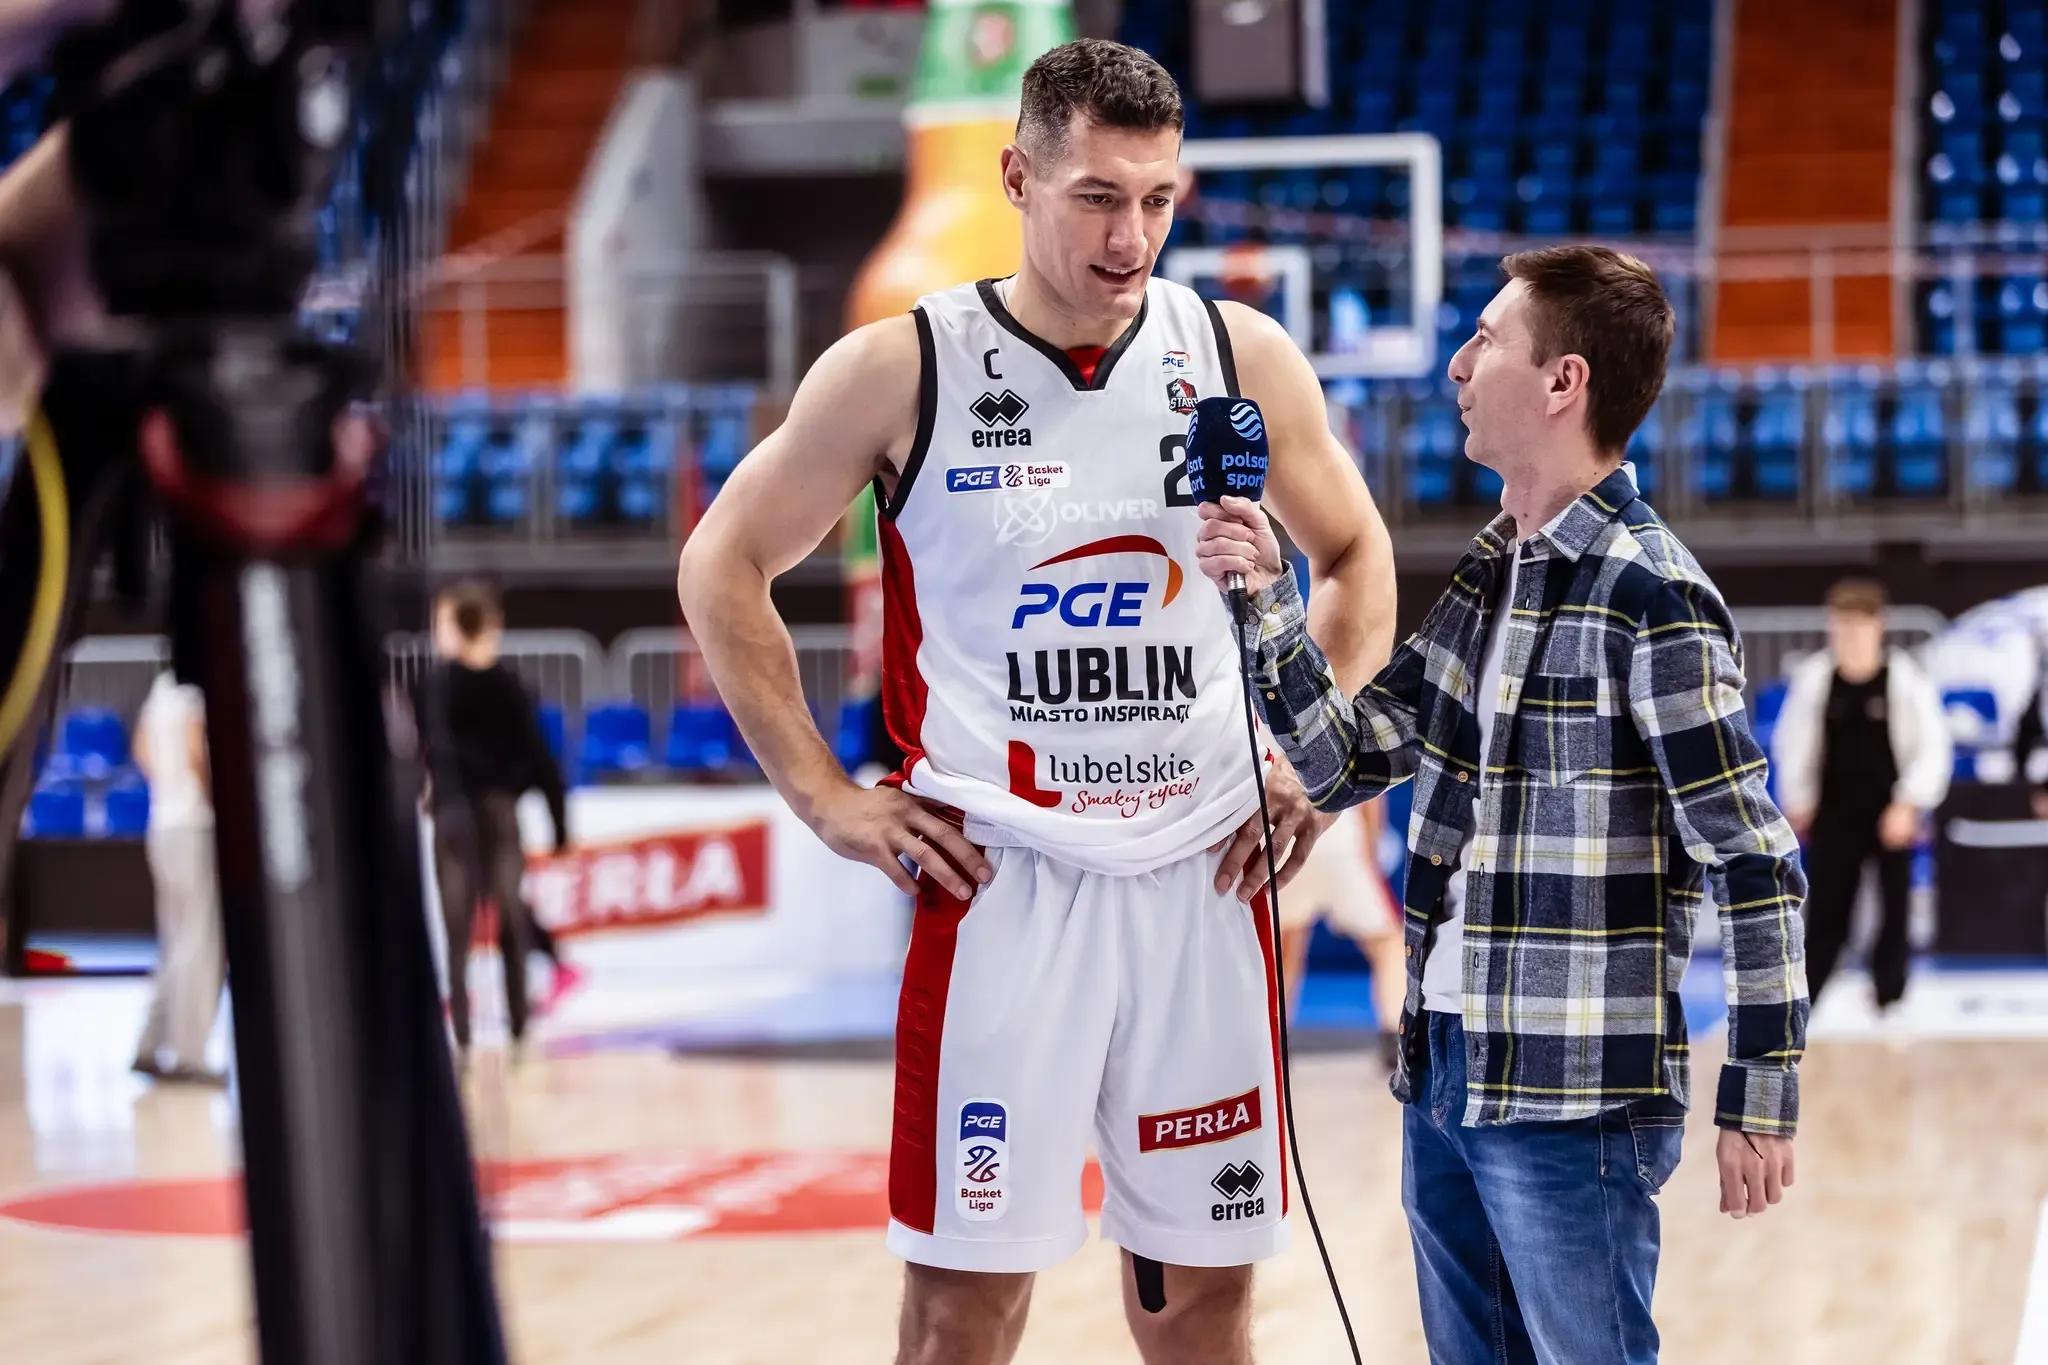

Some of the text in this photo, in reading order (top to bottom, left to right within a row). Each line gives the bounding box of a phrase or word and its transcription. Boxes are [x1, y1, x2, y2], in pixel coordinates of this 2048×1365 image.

[983, 348, 1003, 380] C
[1162, 357, 1185, 368] PGE
[971, 428, 1032, 448] errea
[953, 470, 994, 487] PGE
[1027, 464, 1064, 475] Basket
[1028, 475, 1051, 486] Liga
[1060, 498, 1160, 523] OLIVER
[1011, 582, 1150, 629] PGE
[1005, 645, 1197, 705] LUBLIN
[1009, 705, 1089, 722] MIASTO
[1049, 752, 1195, 784] lubelskie
[1071, 789, 1145, 819] Smakuj
[963, 1115, 1003, 1129] PGE
[1155, 1102, 1250, 1143] PERŁA
[960, 1187, 1002, 1199] Basket
[969, 1199, 994, 1212] Liga
[1211, 1197, 1265, 1221] errea
